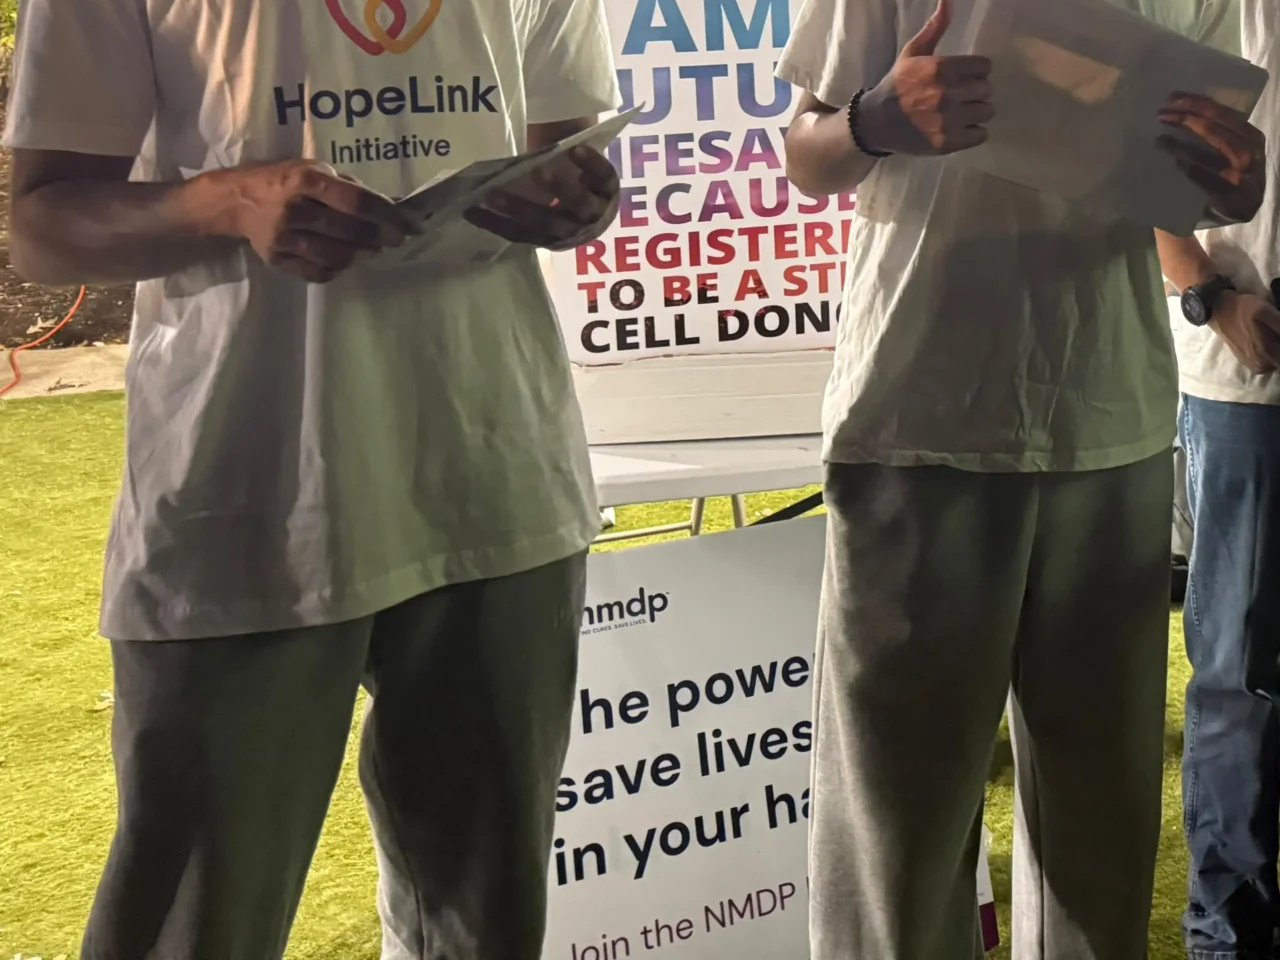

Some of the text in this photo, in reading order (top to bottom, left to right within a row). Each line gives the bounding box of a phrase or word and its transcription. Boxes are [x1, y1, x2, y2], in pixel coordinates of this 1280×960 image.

[272, 75, 499, 127] HopeLink
[330, 133, 451, 164] Initiative
[607, 126, 788, 180] IFESA
[575, 219, 852, 275] REGISTER
[577, 261, 846, 314] TO BE A ST
[580, 300, 844, 354] CELL DON
[580, 652, 815, 734] he powe
[555, 720, 812, 813] save lives
[553, 837, 607, 886] in
[623, 802, 750, 881] your
[640, 919, 694, 950] the
[704, 882, 796, 933] NMDP
